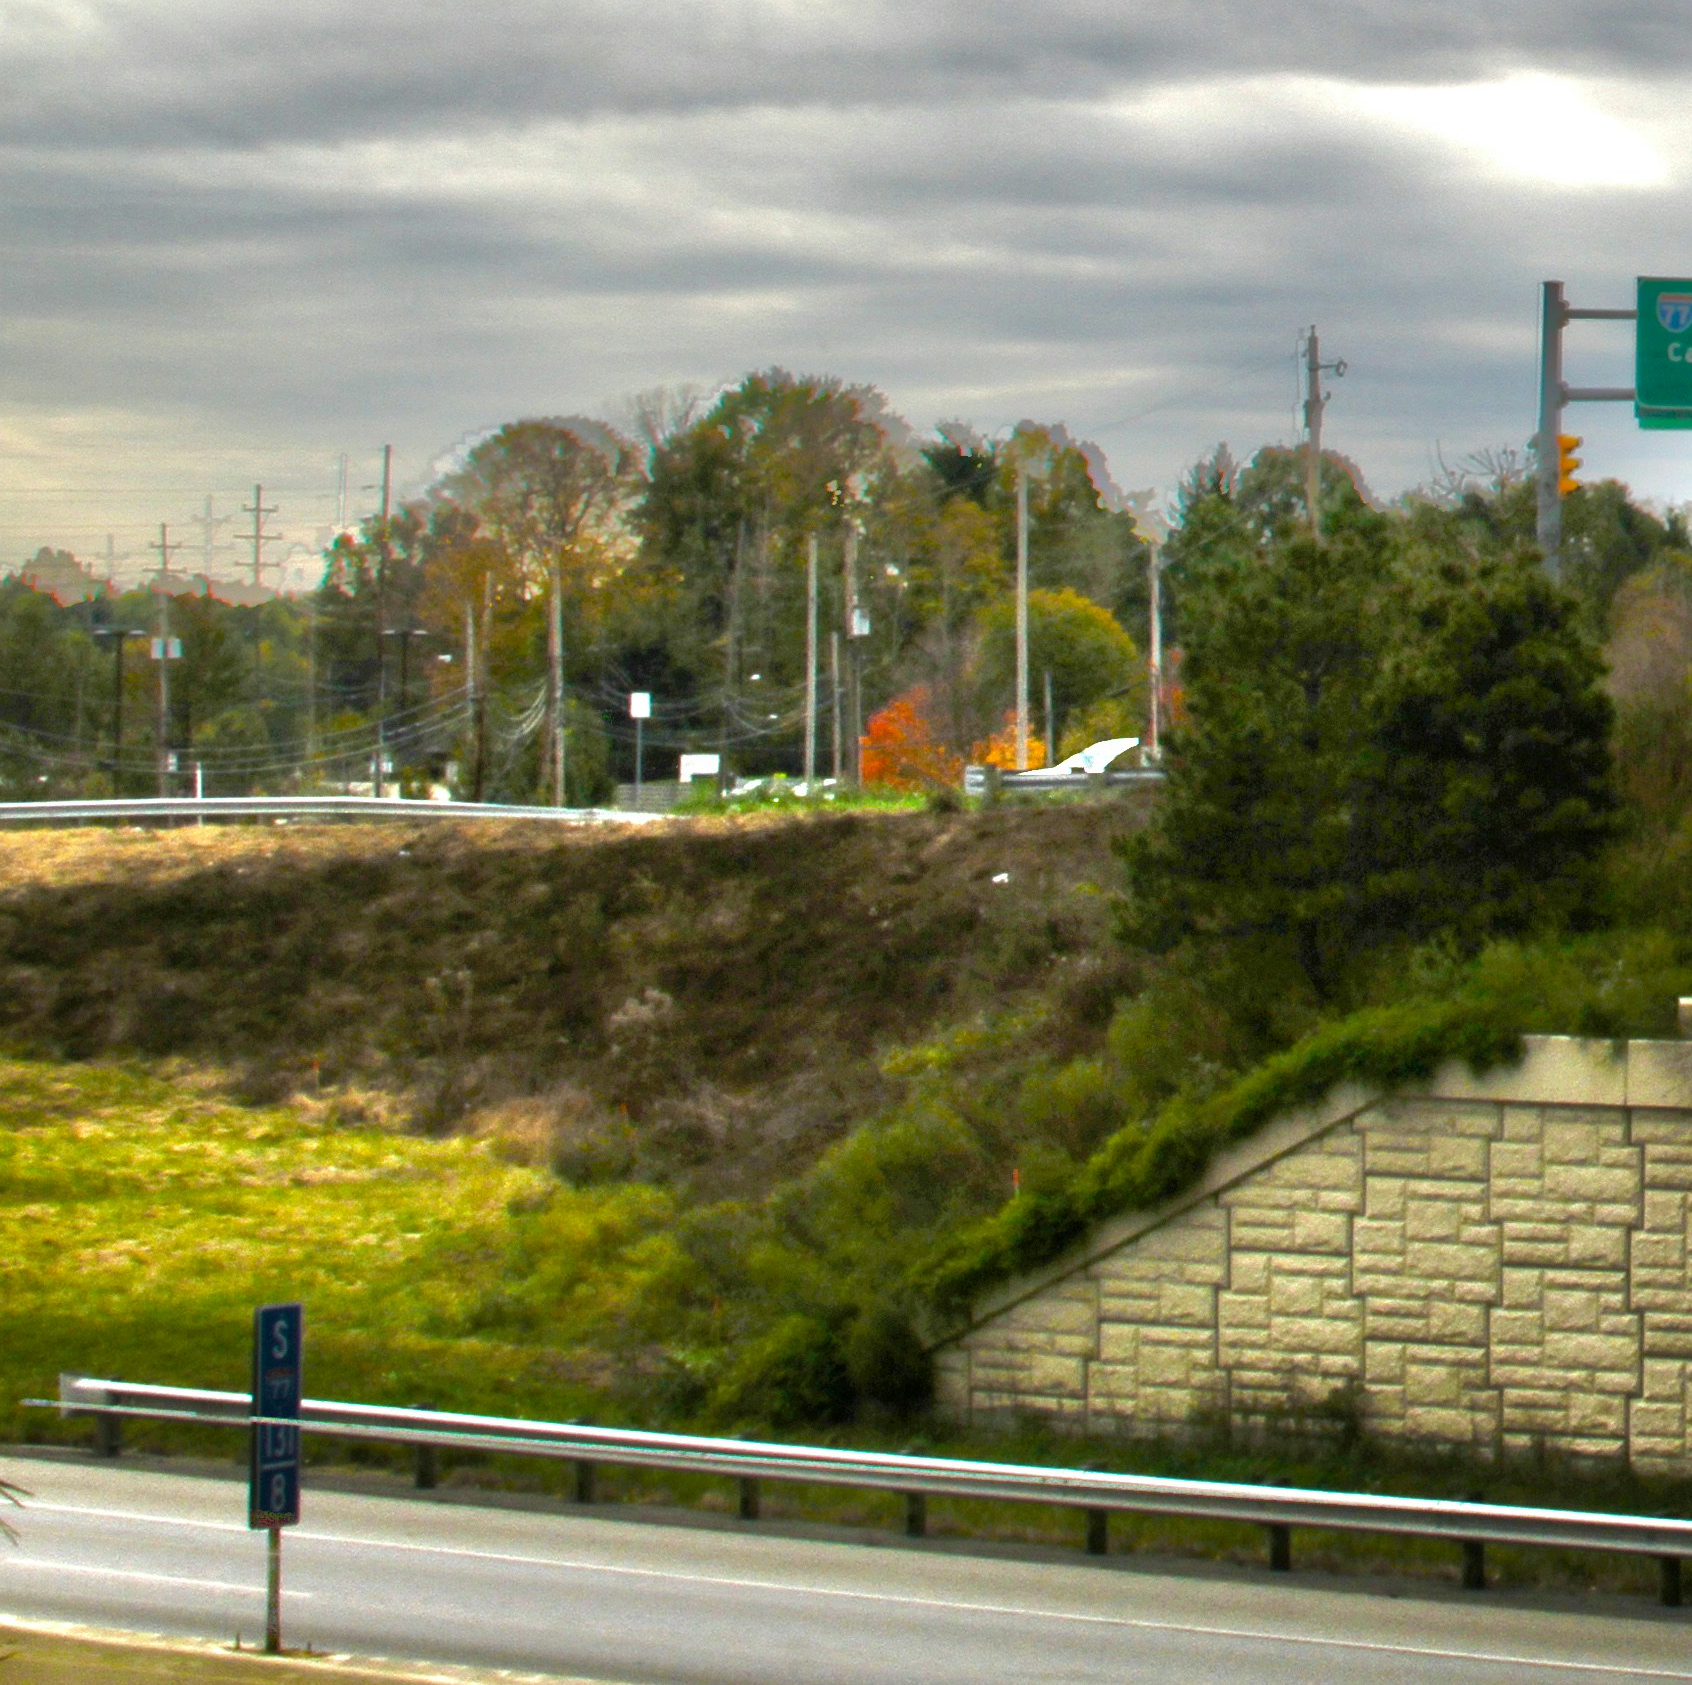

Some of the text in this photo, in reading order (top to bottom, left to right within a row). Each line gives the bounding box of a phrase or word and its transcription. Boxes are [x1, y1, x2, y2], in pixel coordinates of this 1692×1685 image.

[1662, 305, 1690, 324] 77
[272, 1320, 288, 1359] S
[269, 1379, 290, 1399] 77
[264, 1418, 296, 1458] 131
[271, 1473, 286, 1512] 8
